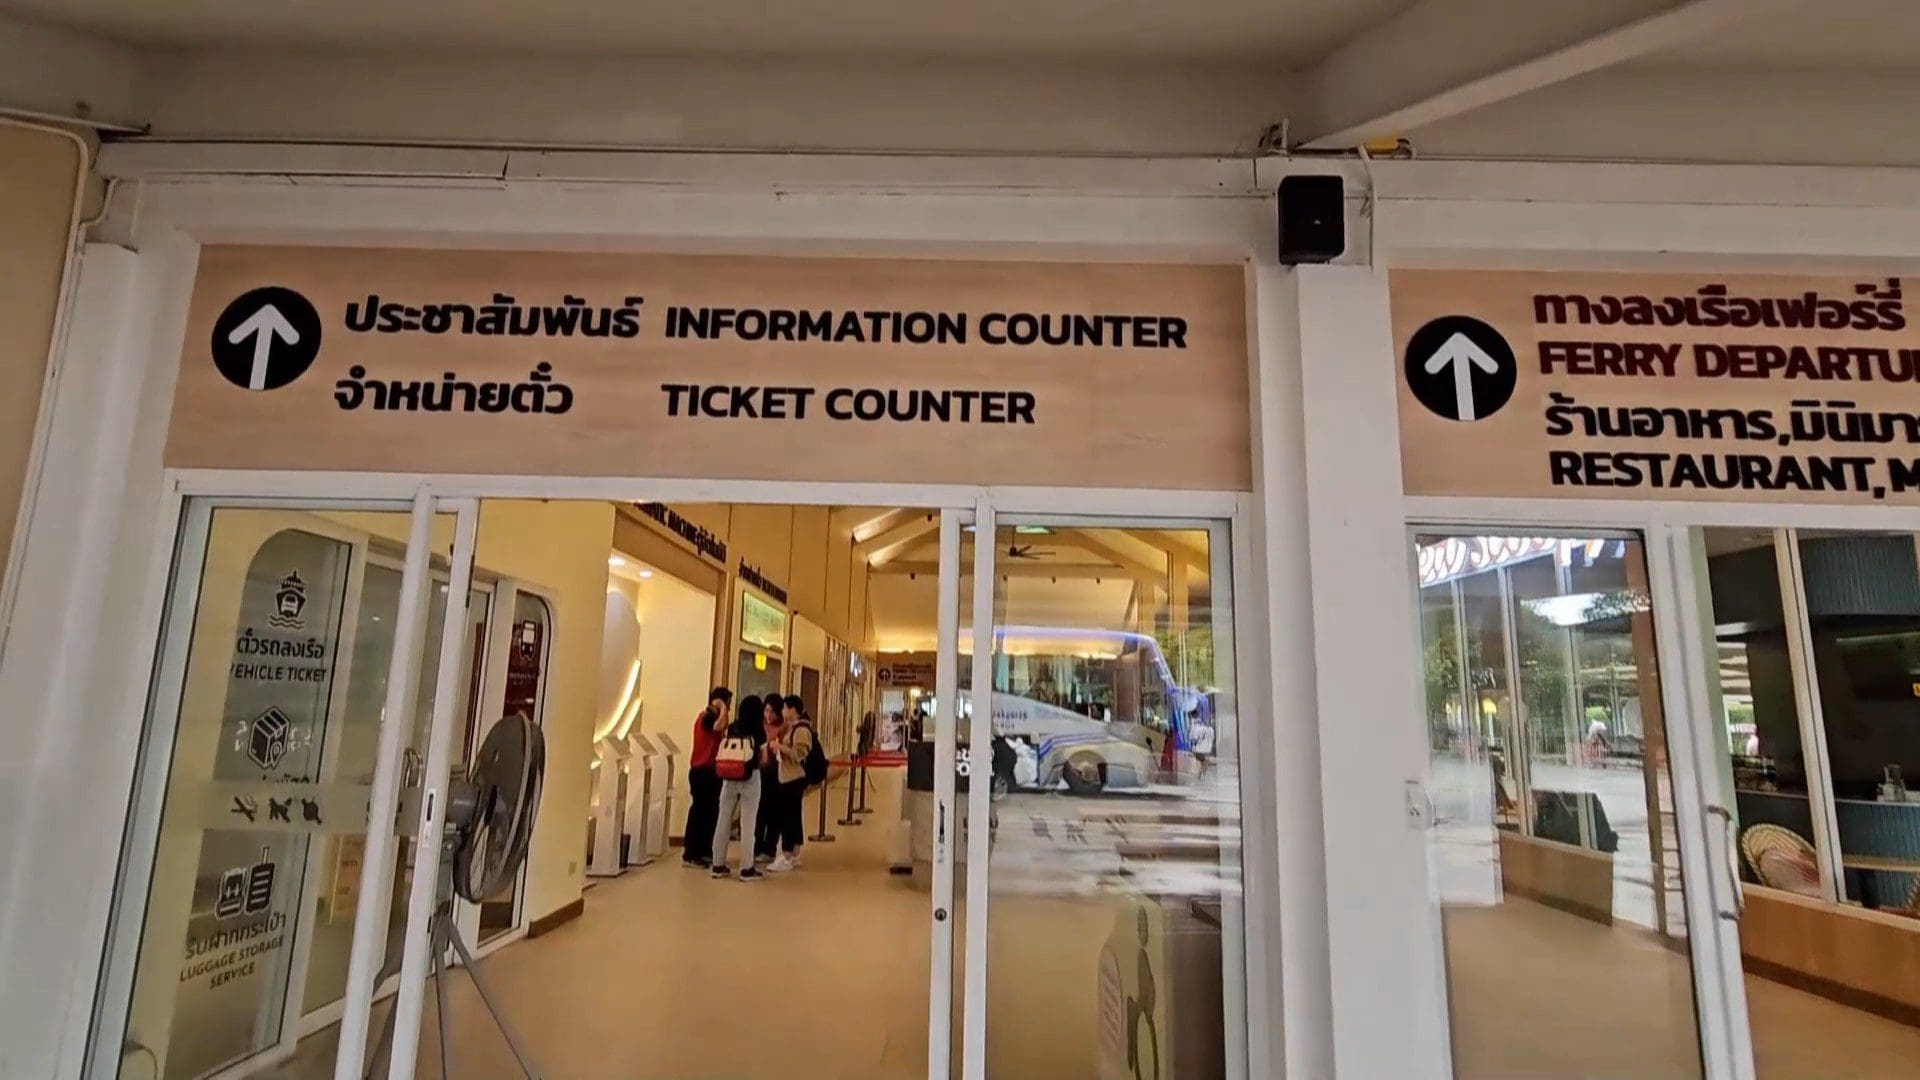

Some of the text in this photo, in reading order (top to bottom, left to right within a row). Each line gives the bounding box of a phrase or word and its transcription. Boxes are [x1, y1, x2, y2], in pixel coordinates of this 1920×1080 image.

[345, 293, 644, 339] ประชาสัมพันธ์
[1532, 277, 1906, 332] ทางลงเรือเฟอร์รี่
[665, 306, 1188, 349] INFORMATION COUNTER
[1537, 340, 1920, 384] FERRY DEPARTU
[333, 361, 574, 415] จำหน่ายตั๋ว
[660, 384, 1036, 424] TICKET COUNTER
[1545, 391, 1920, 448] ร้านอาหาร,มินิมา
[287, 666, 328, 683] TICKET
[180, 934, 284, 982] LUGGAGE STORAGE
[209, 961, 256, 990] SERVICE
